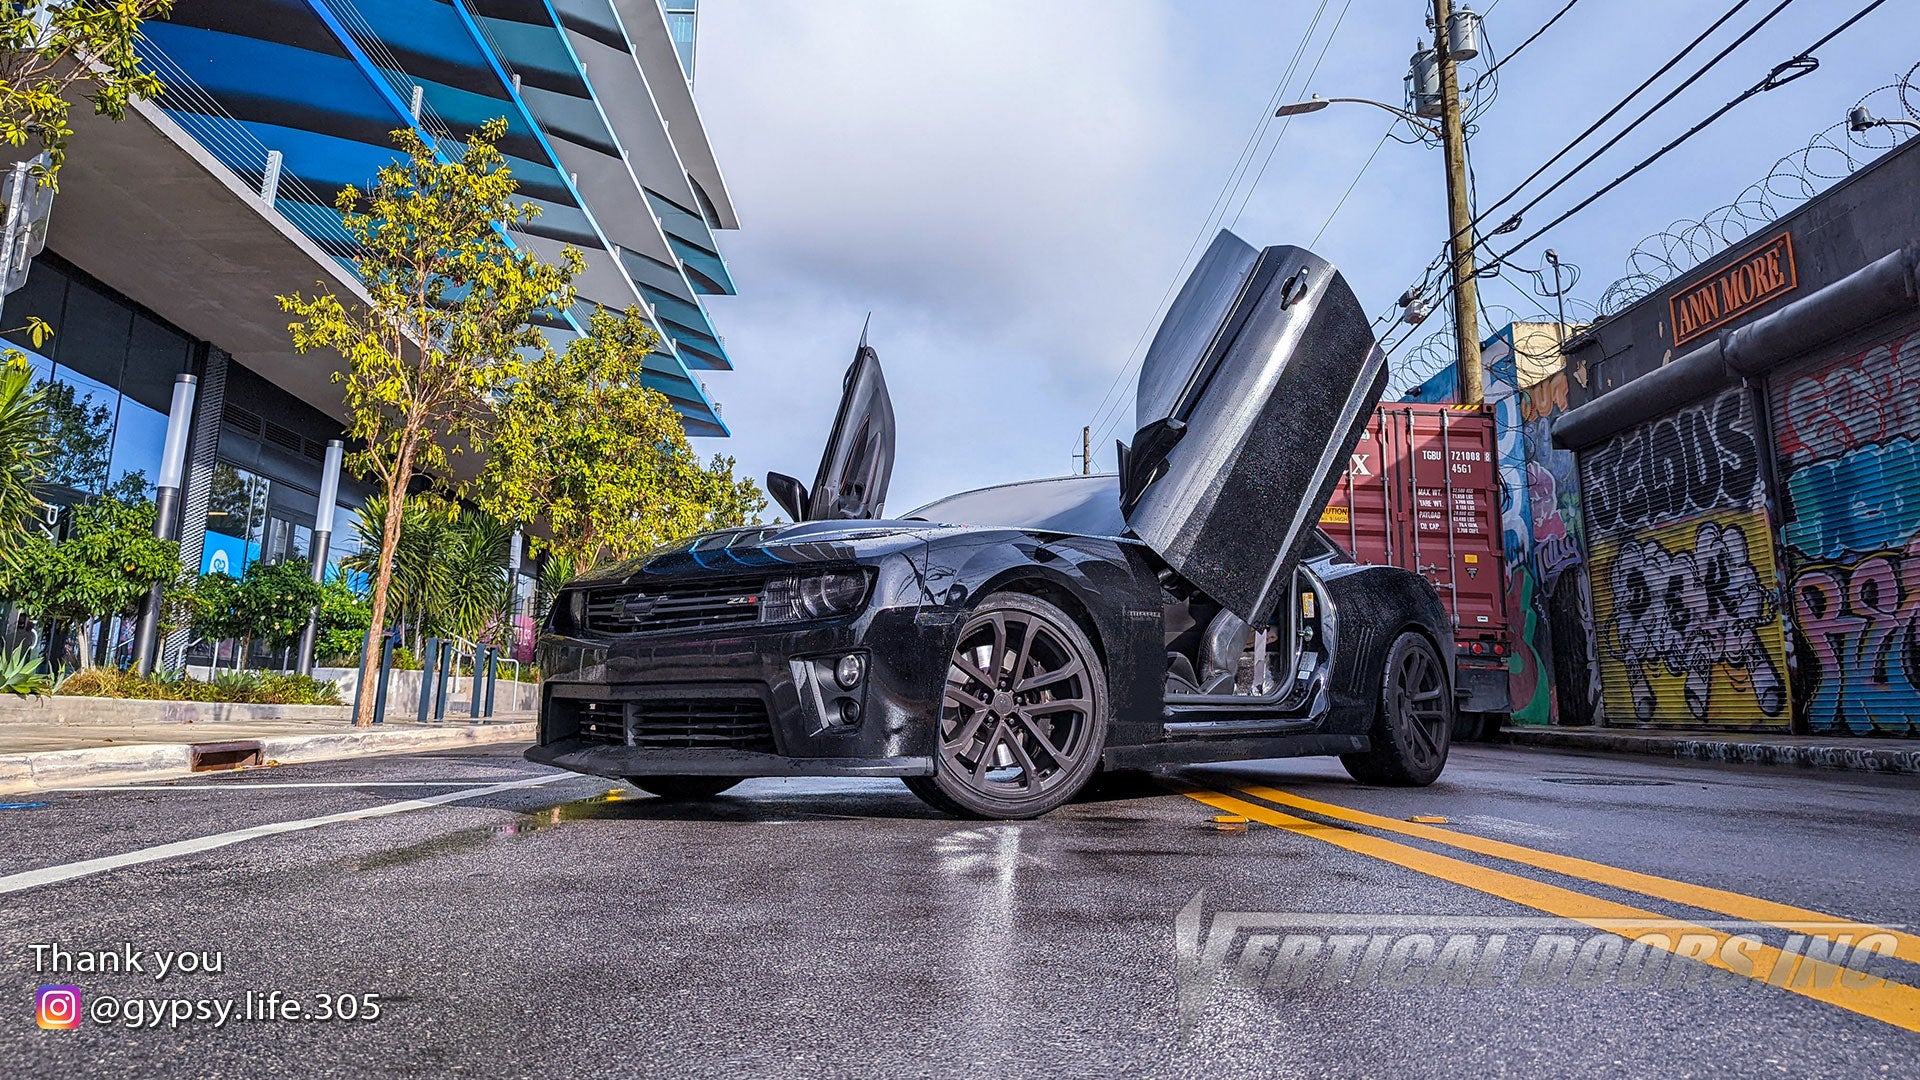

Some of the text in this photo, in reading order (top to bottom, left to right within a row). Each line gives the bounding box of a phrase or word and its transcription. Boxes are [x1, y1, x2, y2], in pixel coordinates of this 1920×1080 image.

[1679, 246, 1786, 337] ANN MORE
[1422, 450, 1441, 461] TGBU
[1450, 451, 1481, 461] 721008
[1451, 463, 1472, 474] 45G1
[1418, 511, 1441, 519] PAYLOAD
